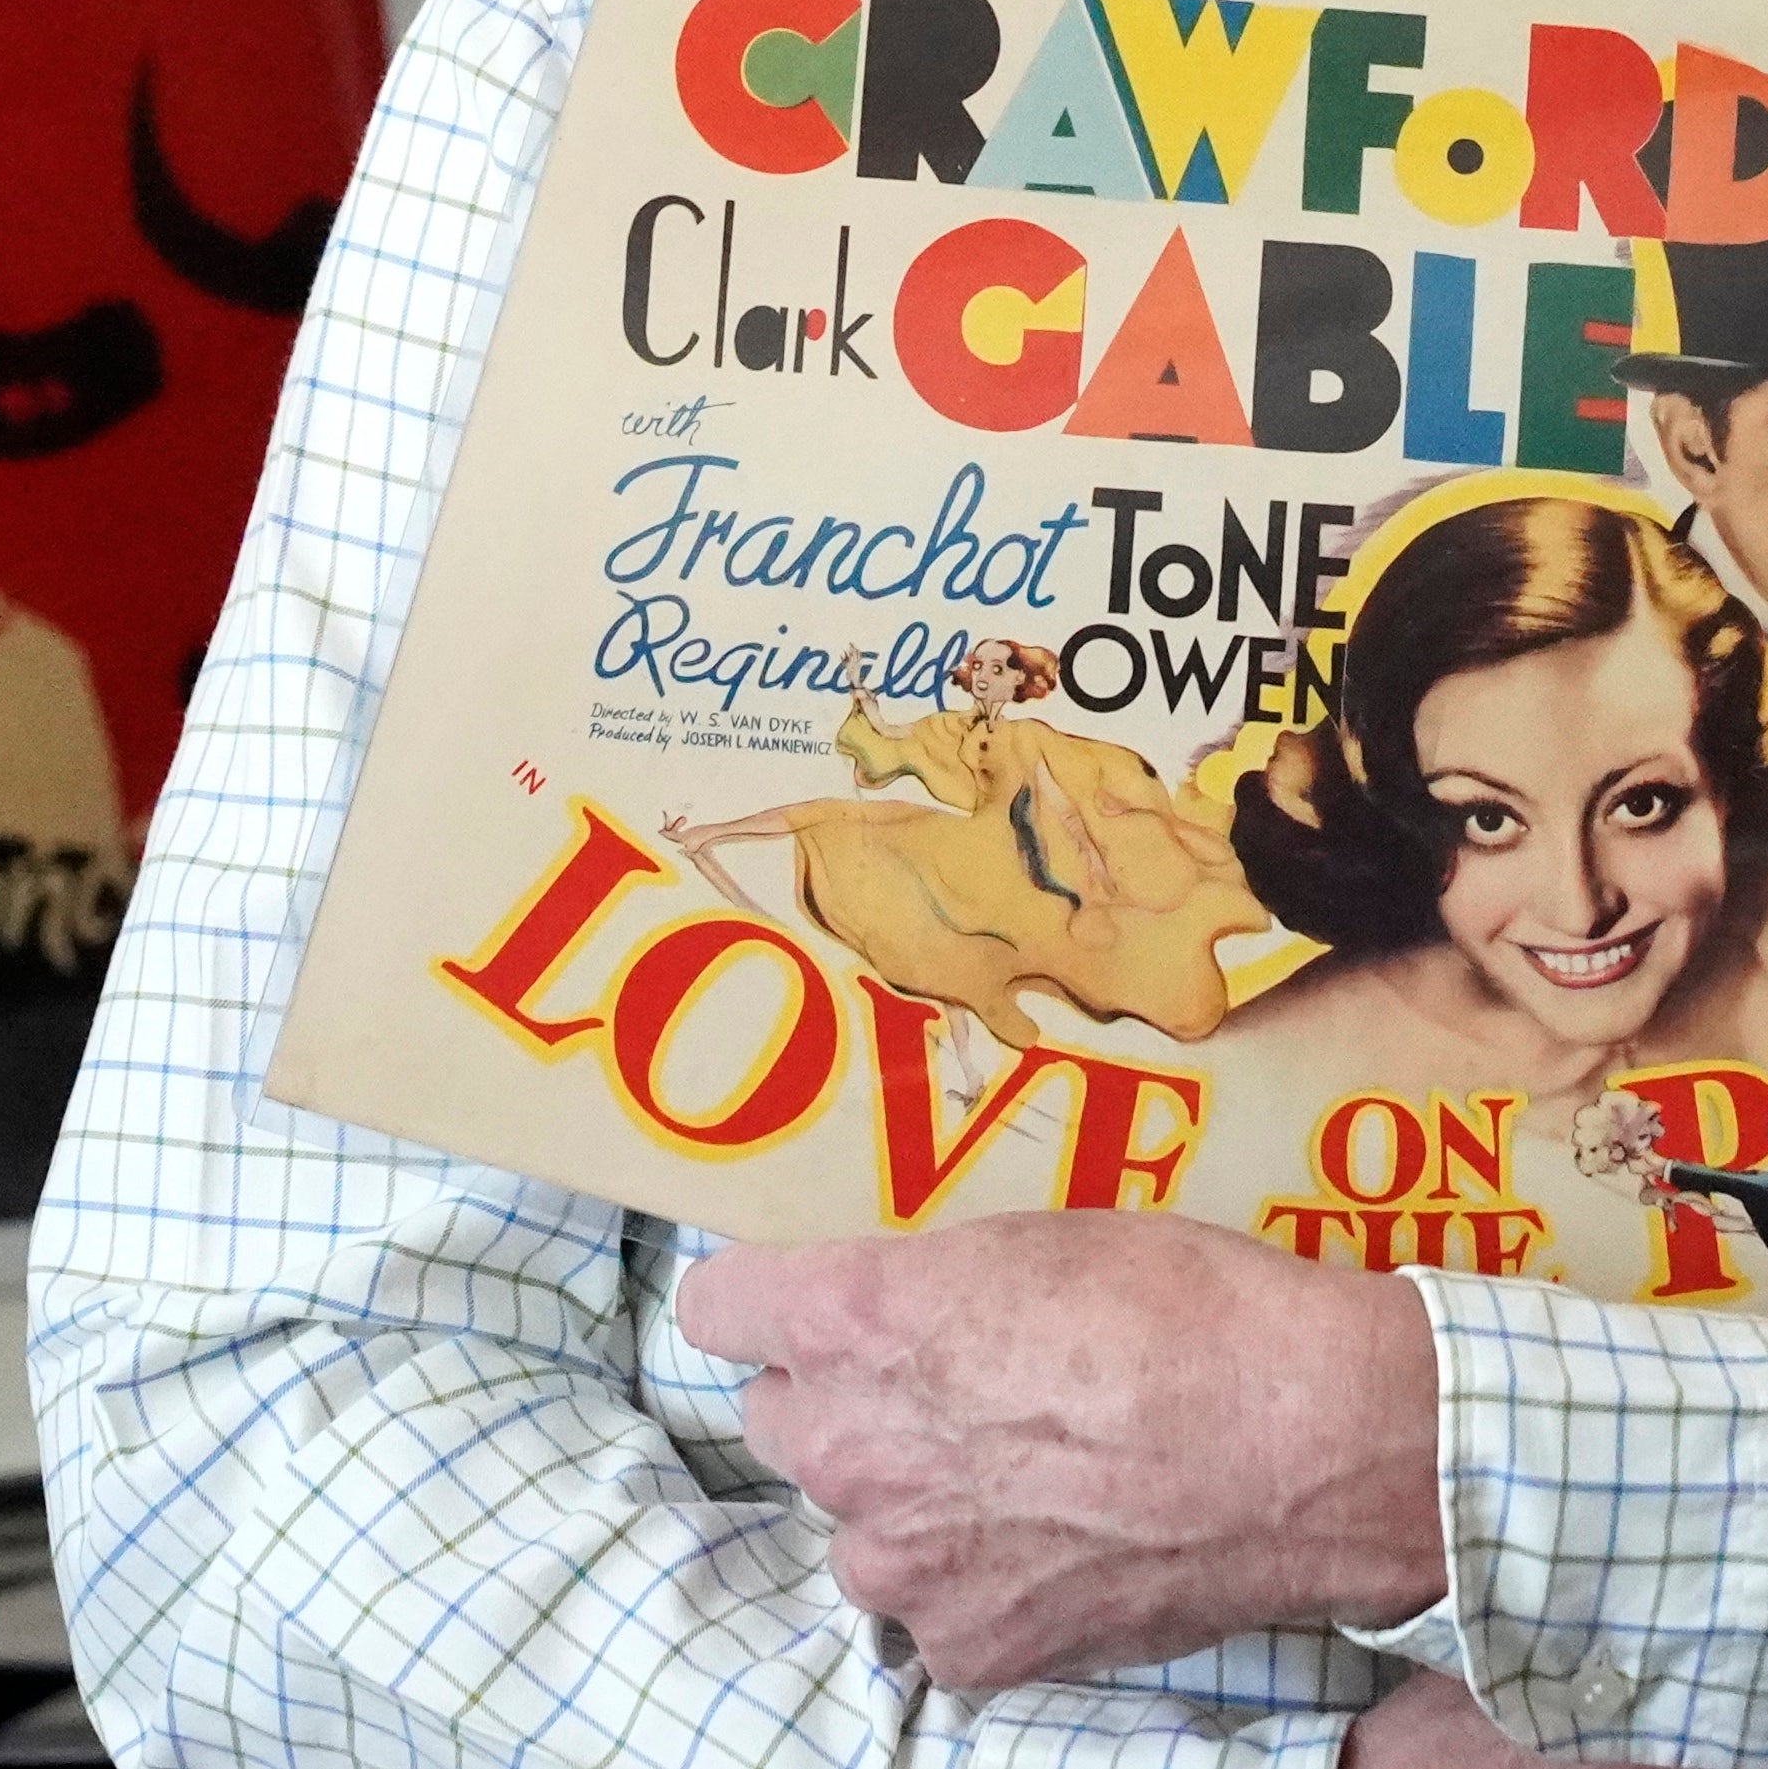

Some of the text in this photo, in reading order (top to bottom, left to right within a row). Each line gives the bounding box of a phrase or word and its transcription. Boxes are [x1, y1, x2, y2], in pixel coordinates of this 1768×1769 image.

[621, 193, 1637, 477] Clark GABLE
[622, 395, 735, 446] with
[603, 453, 1090, 611] Franchot
[592, 590, 1346, 726] Reginald OWEN
[588, 722, 652, 744] Produced
[654, 726, 672, 753] by
[681, 730, 732, 750] JOSEPH
[747, 734, 833, 757] MANKIEWICZ
[590, 702, 654, 724] Directed
[658, 708, 673, 728] by
[730, 714, 762, 731] VAN
[510, 759, 547, 796] IN
[439, 802, 1207, 1223] LOVE
[1319, 1095, 1516, 1206] ON
